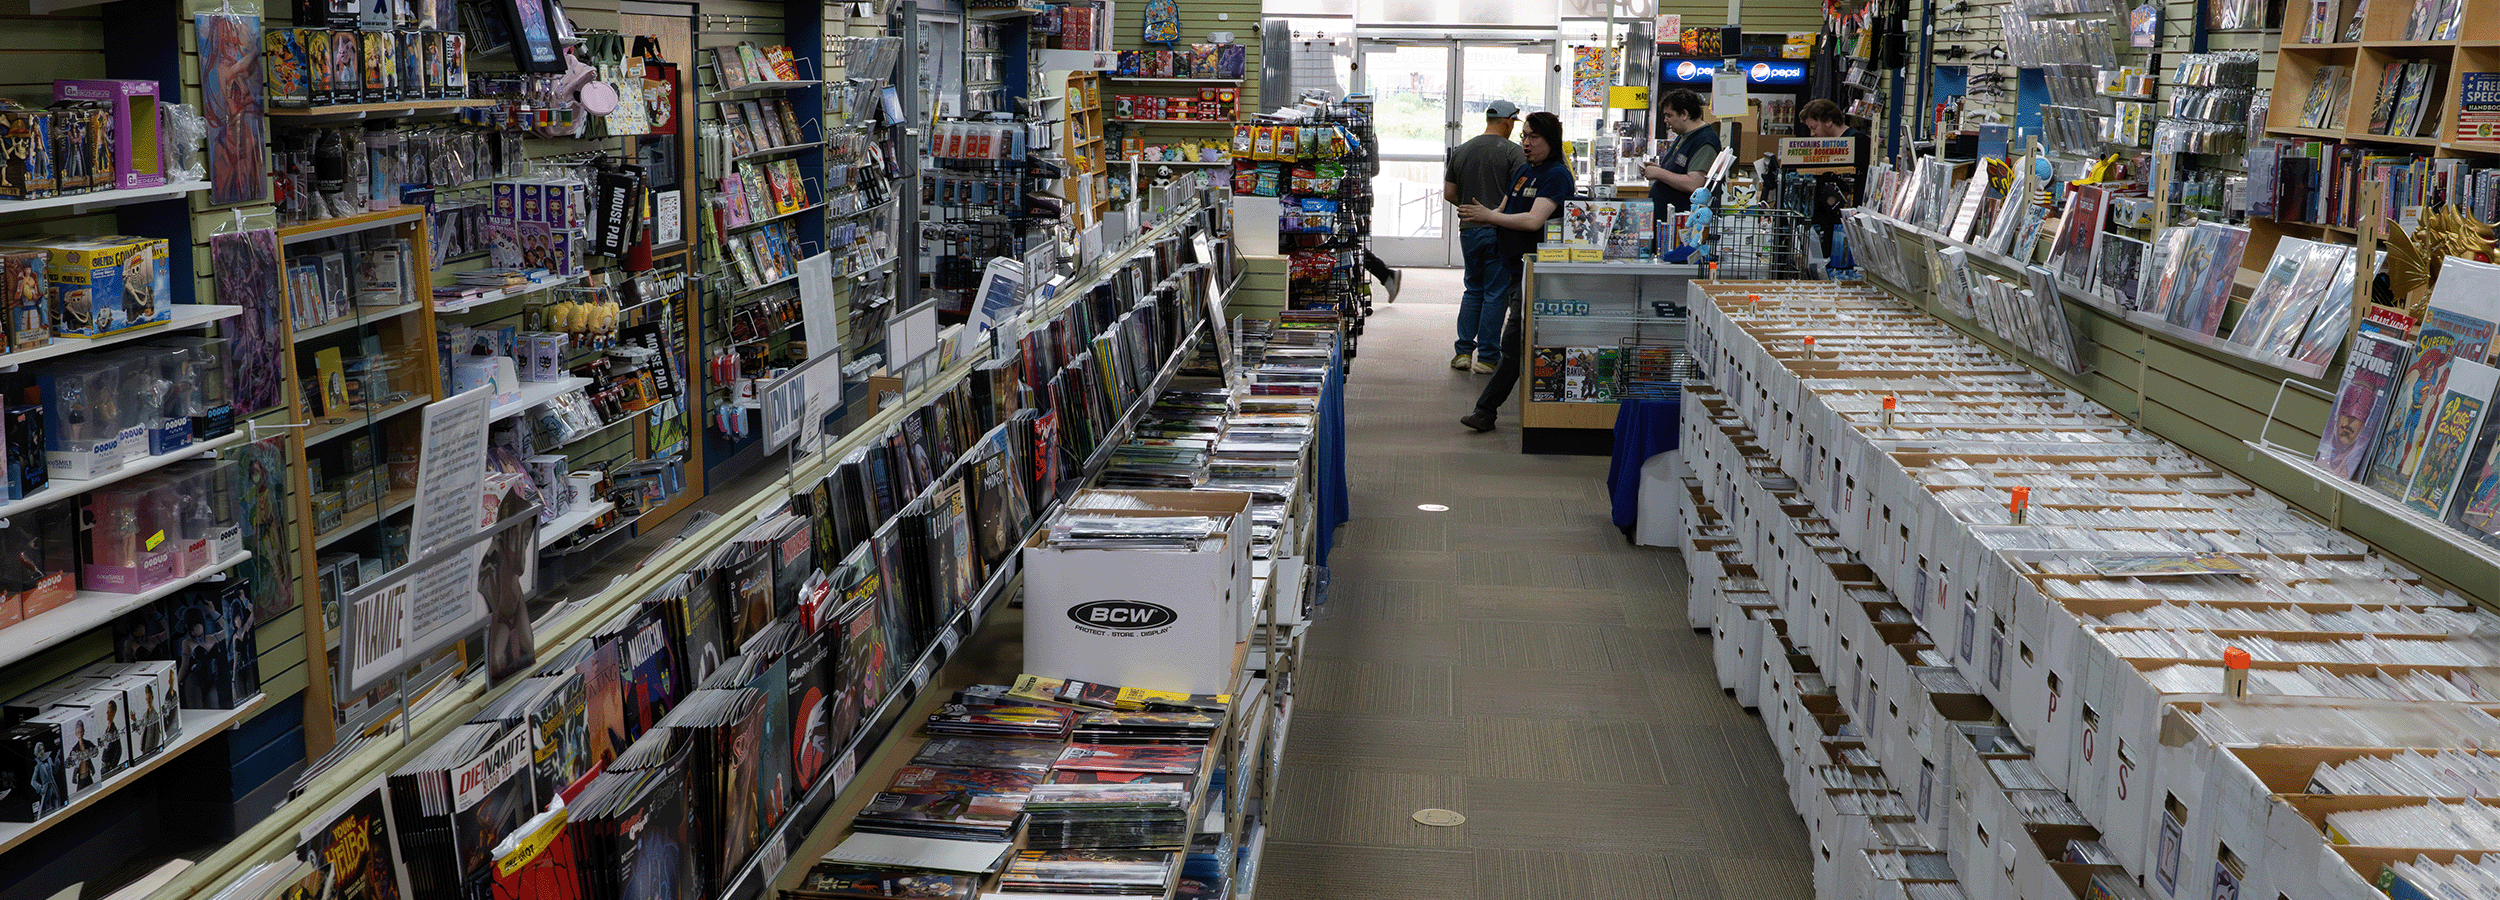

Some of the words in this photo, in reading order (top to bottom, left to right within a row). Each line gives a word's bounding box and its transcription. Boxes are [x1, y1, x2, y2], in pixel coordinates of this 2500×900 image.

[1770, 68, 1800, 79] pepsi
[611, 187, 626, 226] MOUSE
[521, 226, 540, 236] BTS
[606, 228, 620, 248] PAD
[2352, 336, 2377, 355] THE
[2416, 334, 2455, 357] SUPERMAN
[2344, 364, 2357, 380] IS
[2348, 351, 2394, 377] FUTURE
[654, 368, 669, 390] PAD
[770, 384, 788, 432] IDW
[789, 374, 805, 422] IDW
[1844, 488, 1852, 513] H
[1938, 578, 1948, 610] M
[354, 584, 407, 670] YNAMITE
[1090, 606, 1154, 624] BCW
[1074, 624, 1106, 637] PROTECT
[628, 620, 666, 670] MALEFICENT
[2048, 692, 2057, 723] P
[2082, 729, 2094, 766] Q
[458, 730, 527, 796] DIE!NAMITE
[482, 771, 500, 795] BLOOD
[501, 762, 513, 780] RED
[2118, 764, 2128, 801] S
[332, 814, 356, 840] YOUNG
[325, 816, 370, 884] HELLBOY
